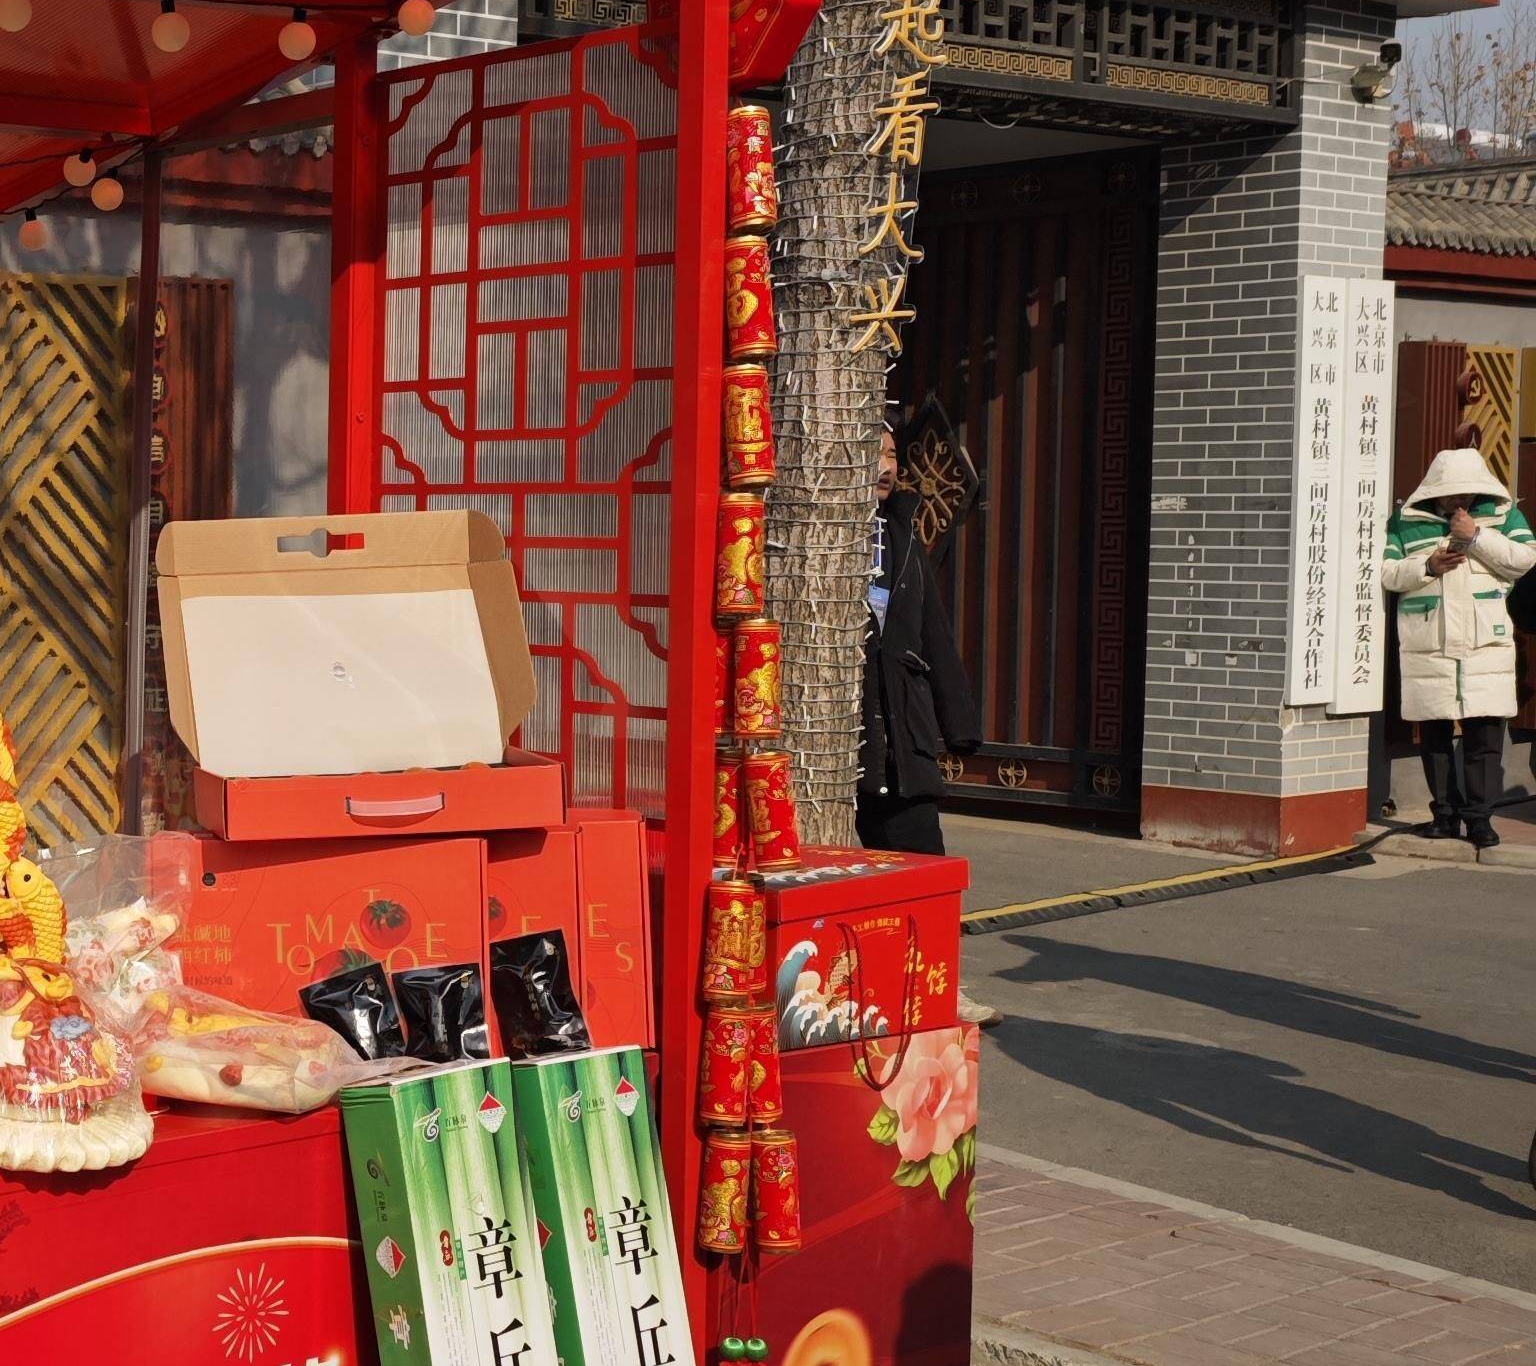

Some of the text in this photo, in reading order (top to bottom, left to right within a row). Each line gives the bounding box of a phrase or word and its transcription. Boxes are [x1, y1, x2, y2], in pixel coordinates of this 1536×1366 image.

[1310, 290, 1324, 385] 大兴区
[1325, 291, 1339, 386] 北京市
[1354, 296, 1371, 375] 大兴区
[1372, 297, 1388, 376] 北京市
[1304, 397, 1332, 690] 黄村镇三间房村股份经济合作社
[1351, 394, 1380, 685] 黄村镇三间房村村务监督委员会
